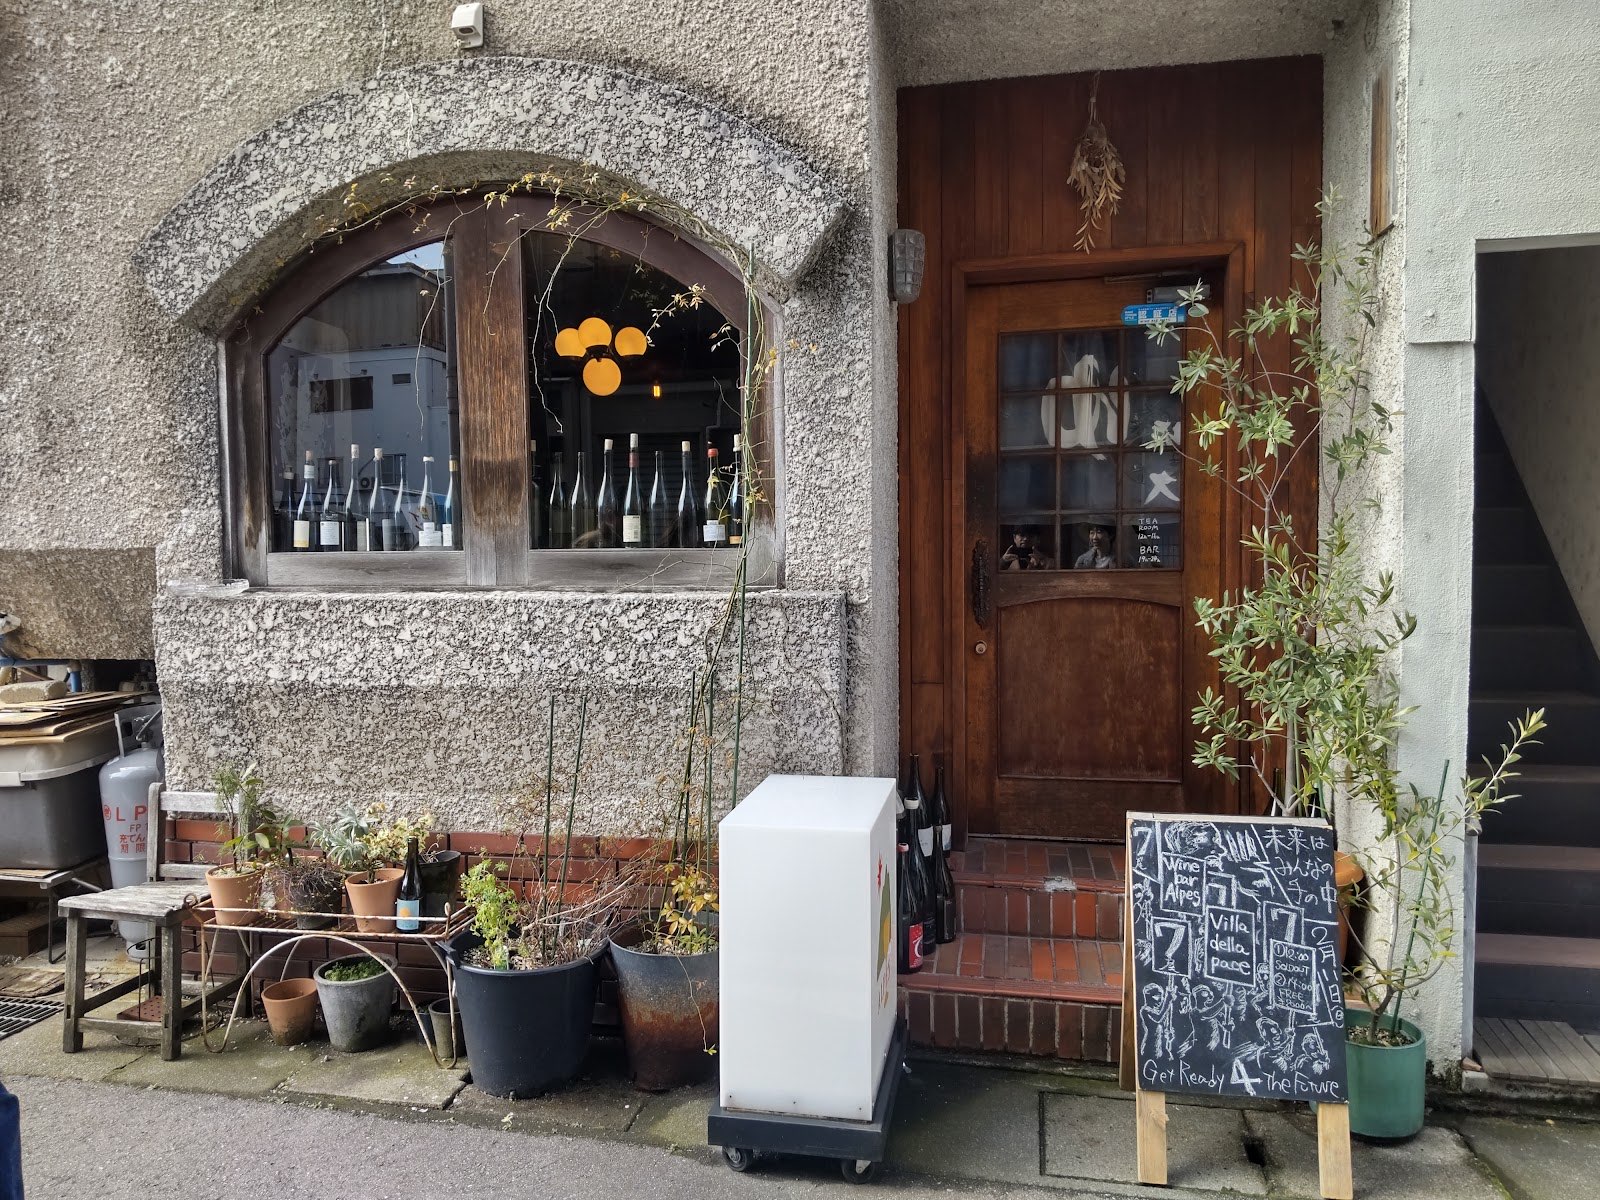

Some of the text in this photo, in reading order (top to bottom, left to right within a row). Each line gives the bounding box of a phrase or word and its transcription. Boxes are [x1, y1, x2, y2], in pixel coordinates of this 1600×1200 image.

[1139, 545, 1160, 555] BAR
[1262, 826, 1330, 855] 未来は
[1162, 856, 1200, 873] Wine
[1274, 856, 1334, 881] みんなの
[1174, 870, 1199, 887] bar
[1164, 881, 1201, 907] Alpes
[1209, 912, 1251, 934] Villa
[1154, 921, 1186, 959] 7
[1209, 933, 1251, 956] della
[1143, 1059, 1175, 1085] Get
[1179, 1059, 1225, 1094] Ready
[1230, 1057, 1263, 1096] 4
[1263, 1071, 1291, 1094] The
